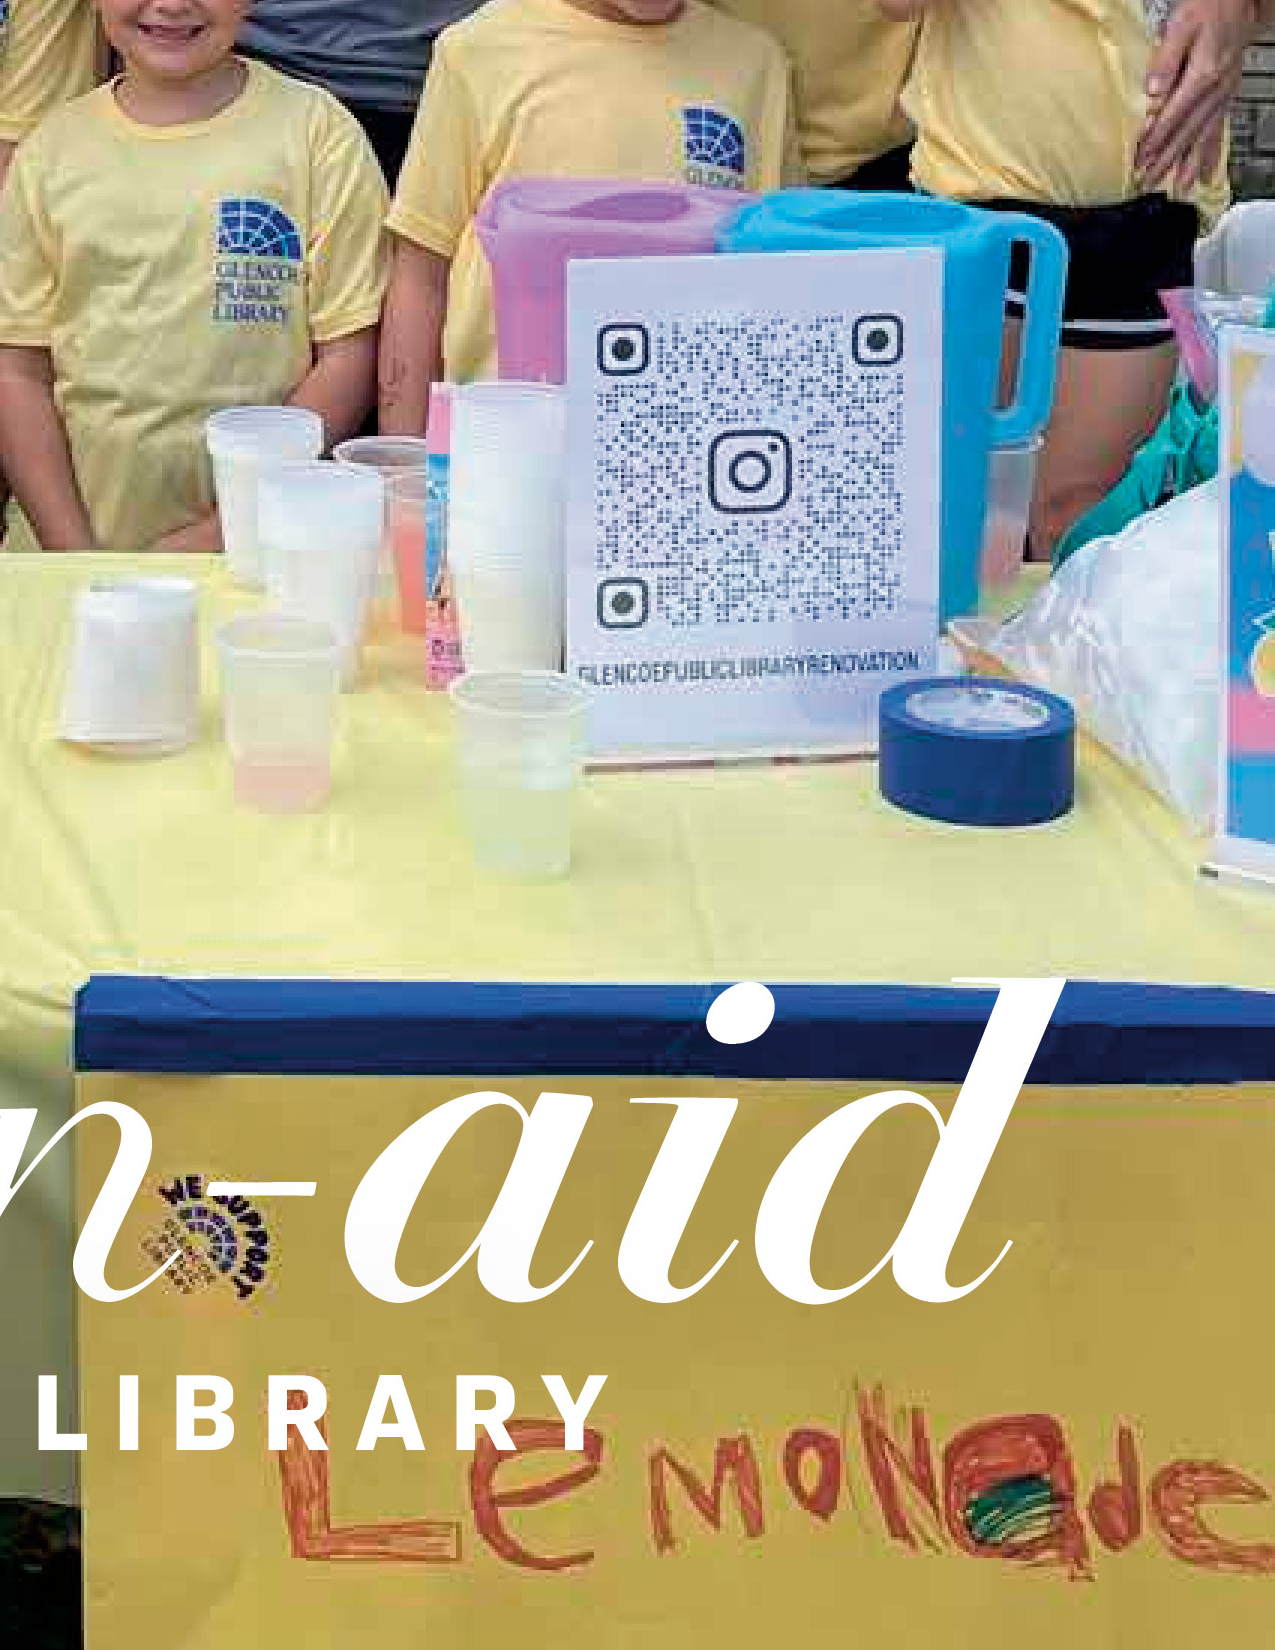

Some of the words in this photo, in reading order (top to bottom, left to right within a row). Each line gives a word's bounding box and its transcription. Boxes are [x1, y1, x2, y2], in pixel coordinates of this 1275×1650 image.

[216, 261, 298, 282] GLENCOE
[216, 282, 280, 301] PUBLIC
[212, 303, 289, 323] LIBRARY
[157, 1174, 202, 1206] WE
